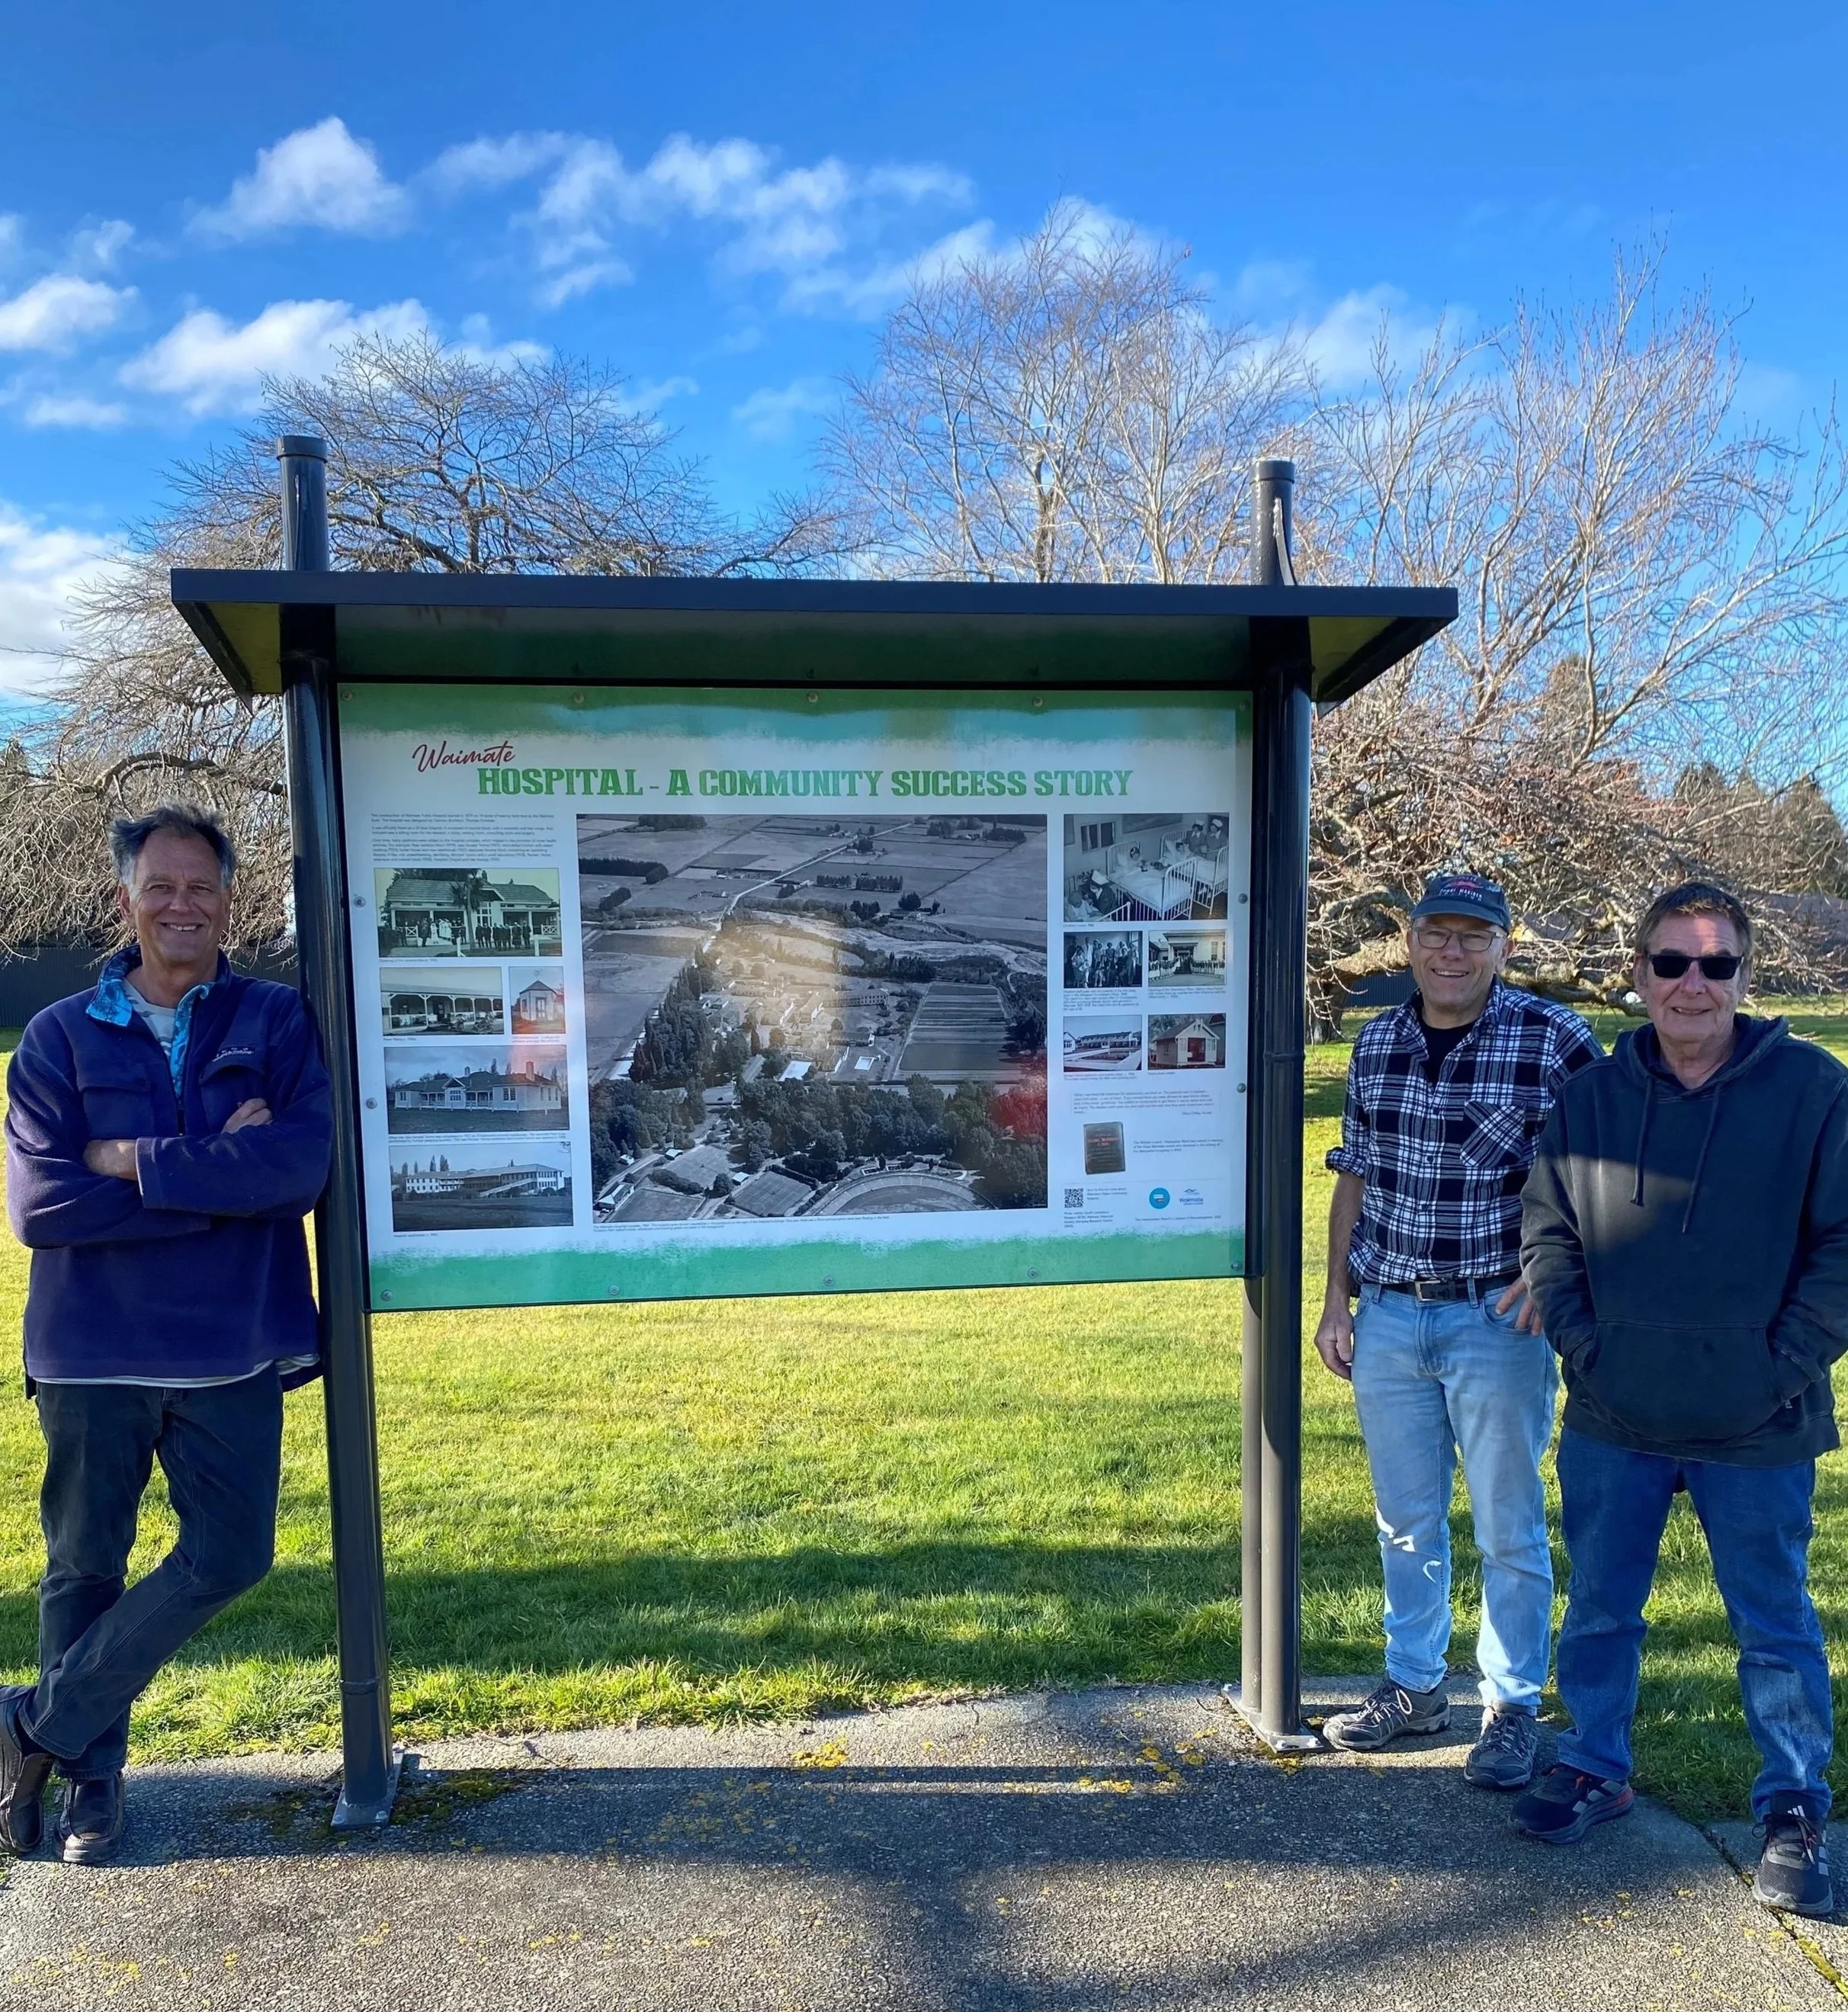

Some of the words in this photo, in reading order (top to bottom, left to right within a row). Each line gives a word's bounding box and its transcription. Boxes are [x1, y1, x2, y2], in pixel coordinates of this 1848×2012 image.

[412, 740, 516, 773] Waimate
[477, 768, 643, 795] HOSPITAL
[666, 769, 693, 796] A
[699, 769, 884, 796] COMMUNITY
[891, 770, 1027, 797] SUCCESS
[1034, 770, 1133, 796] STORY
